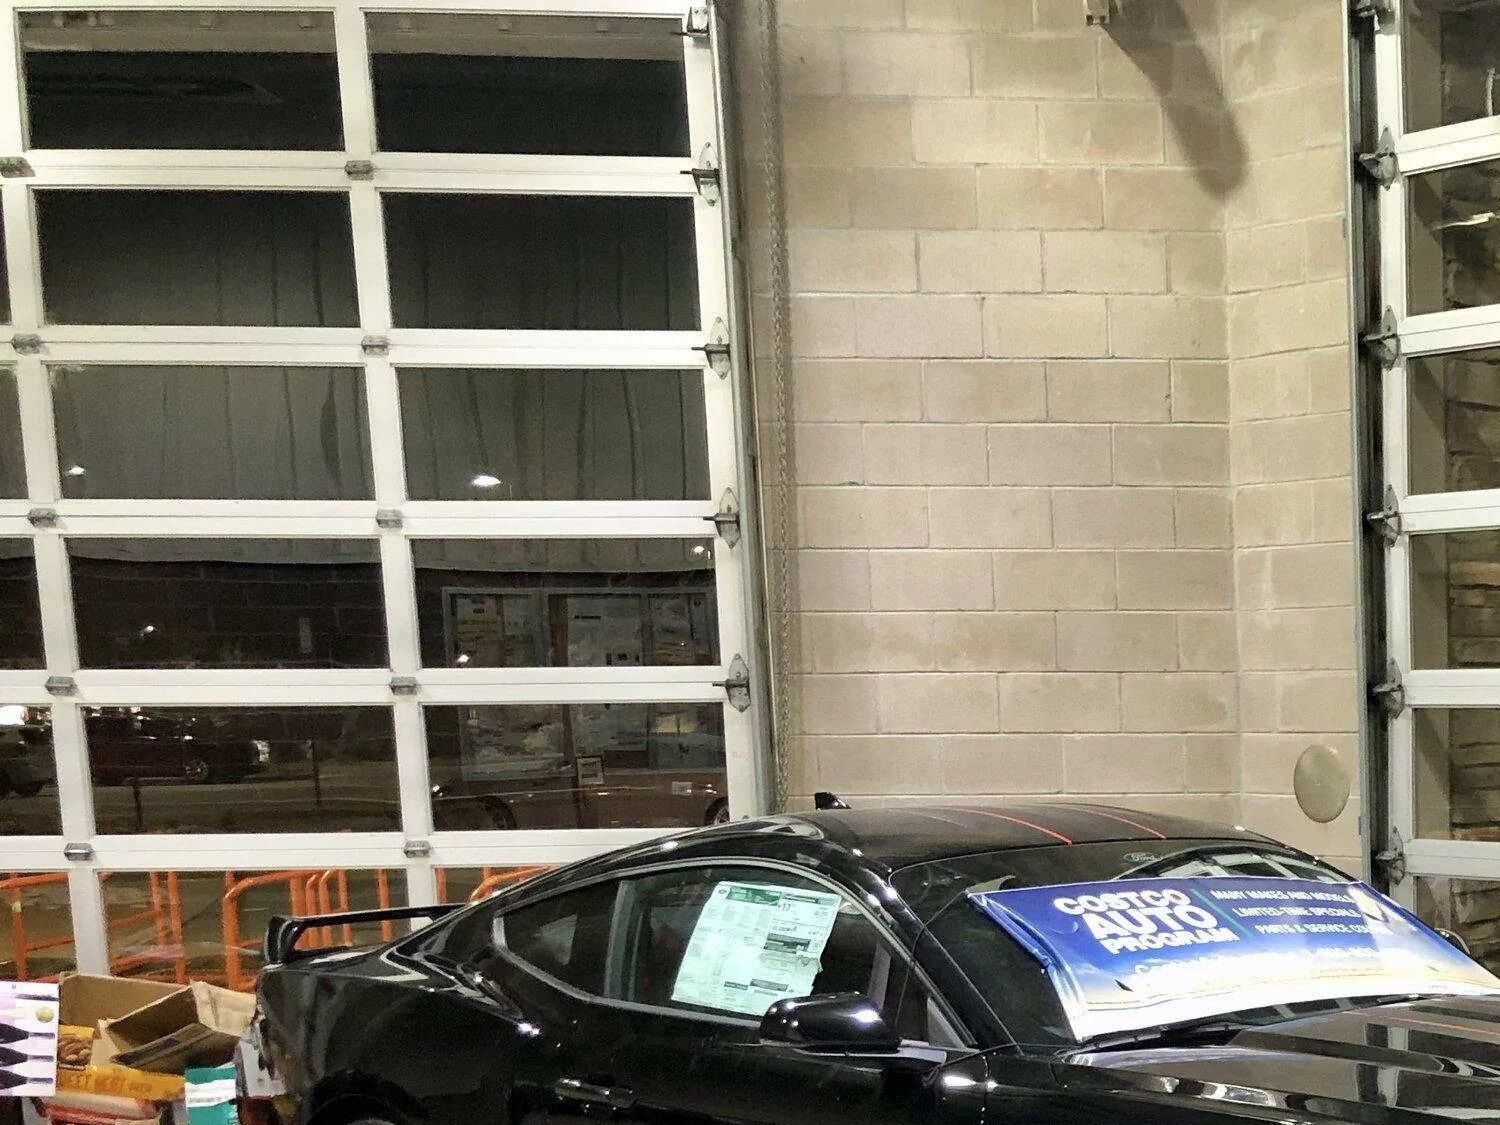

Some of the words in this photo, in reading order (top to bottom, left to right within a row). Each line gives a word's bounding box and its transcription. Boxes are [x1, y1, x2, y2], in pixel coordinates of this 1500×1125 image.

[1053, 889, 1191, 916] COSTCO
[1209, 890, 1247, 900] MANY
[1246, 890, 1289, 900] MAKES
[1082, 905, 1218, 940] AUTO
[1099, 927, 1240, 955] PROGRAM
